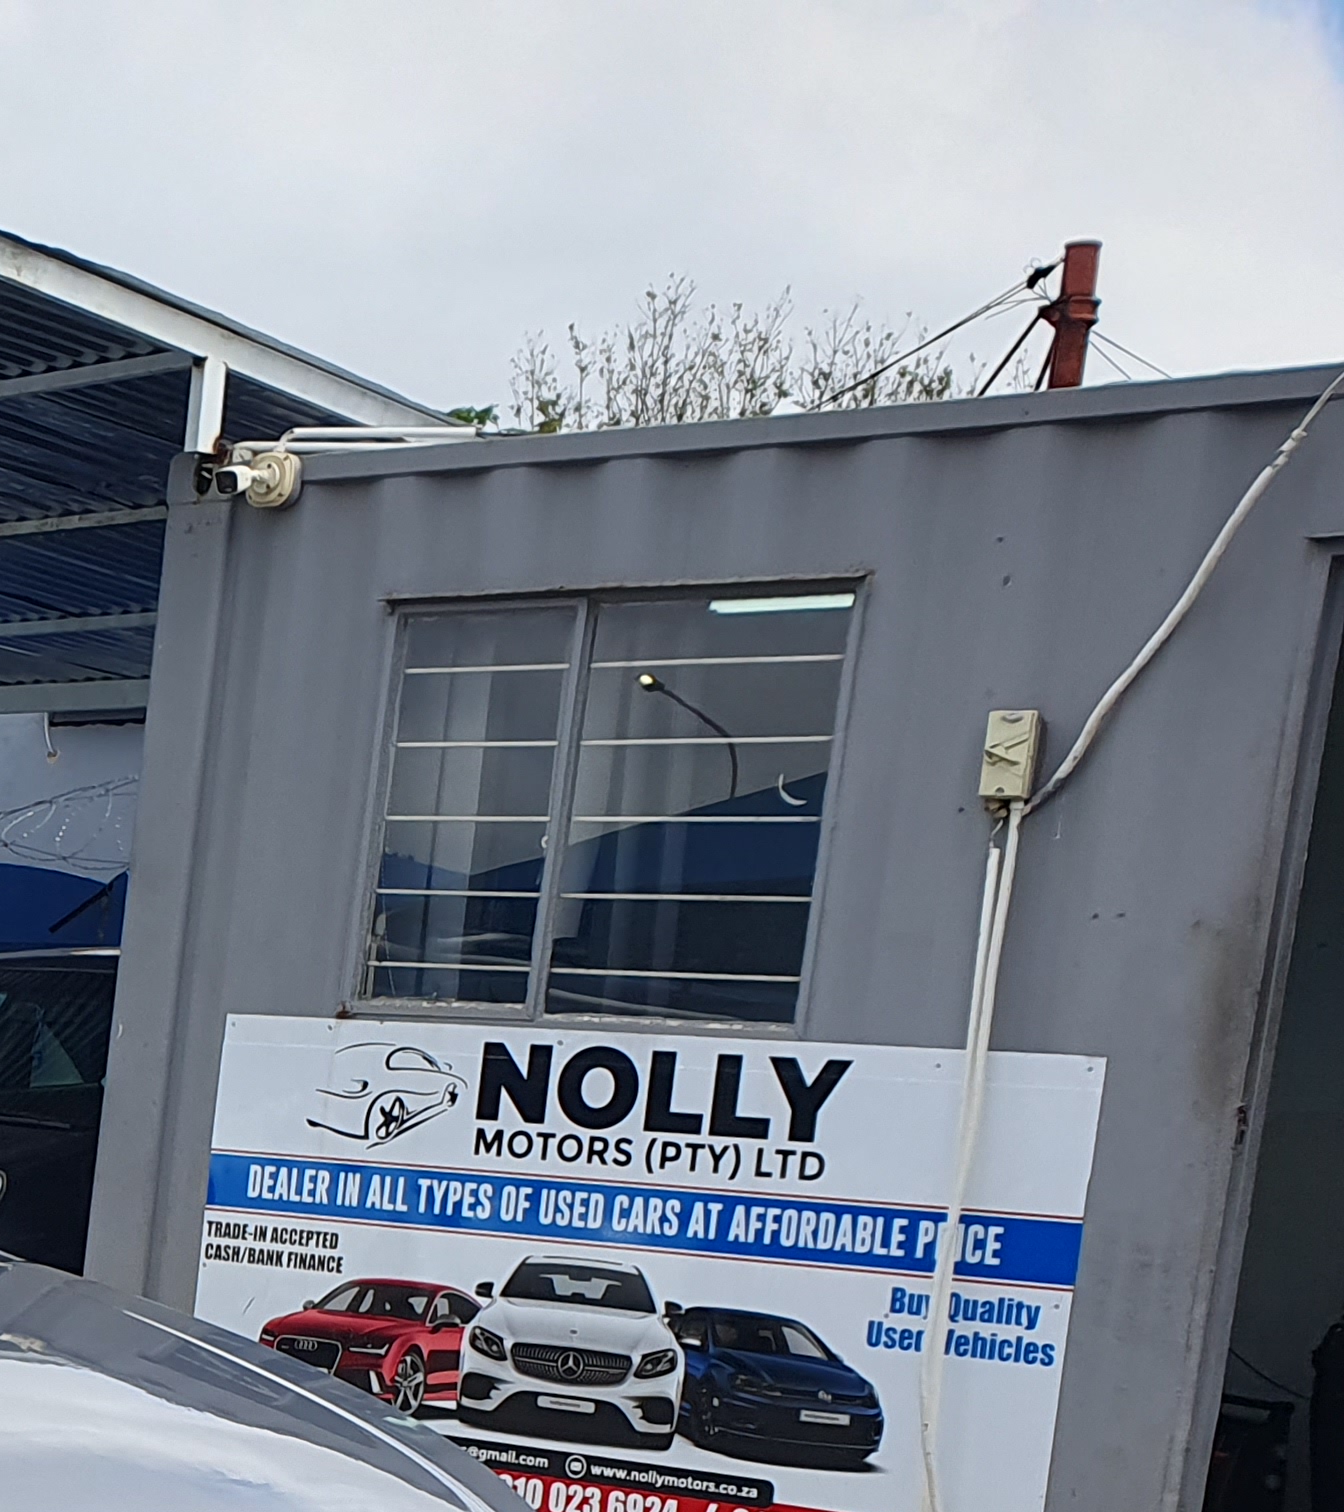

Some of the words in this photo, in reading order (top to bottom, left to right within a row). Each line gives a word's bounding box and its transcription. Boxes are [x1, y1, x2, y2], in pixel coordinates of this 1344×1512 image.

[475, 1041, 854, 1143] NOLLY
[473, 1127, 633, 1167] MOTORS
[644, 1137, 742, 1180] (PTY)
[754, 1148, 826, 1181] LTD
[206, 1221, 267, 1243] TRADE-IN
[271, 1227, 340, 1250] ACCEPTED
[247, 1163, 330, 1206] DEALER
[336, 1171, 362, 1208] IN
[365, 1174, 409, 1212] ALL
[417, 1178, 492, 1221] TYPES
[500, 1184, 534, 1223] OF
[538, 1189, 605, 1231] USED
[611, 1194, 679, 1237] CARS
[687, 1201, 724, 1240] AT
[727, 1205, 909, 1258] AFFORDABLE
[204, 1244, 285, 1269] CASH/BANK
[286, 1252, 344, 1275] FINANCE
[948, 1291, 1041, 1331] Quality
[459, 1446, 549, 1469] @gmail.com
[590, 1463, 759, 1500] www.nollymotors.co.za
